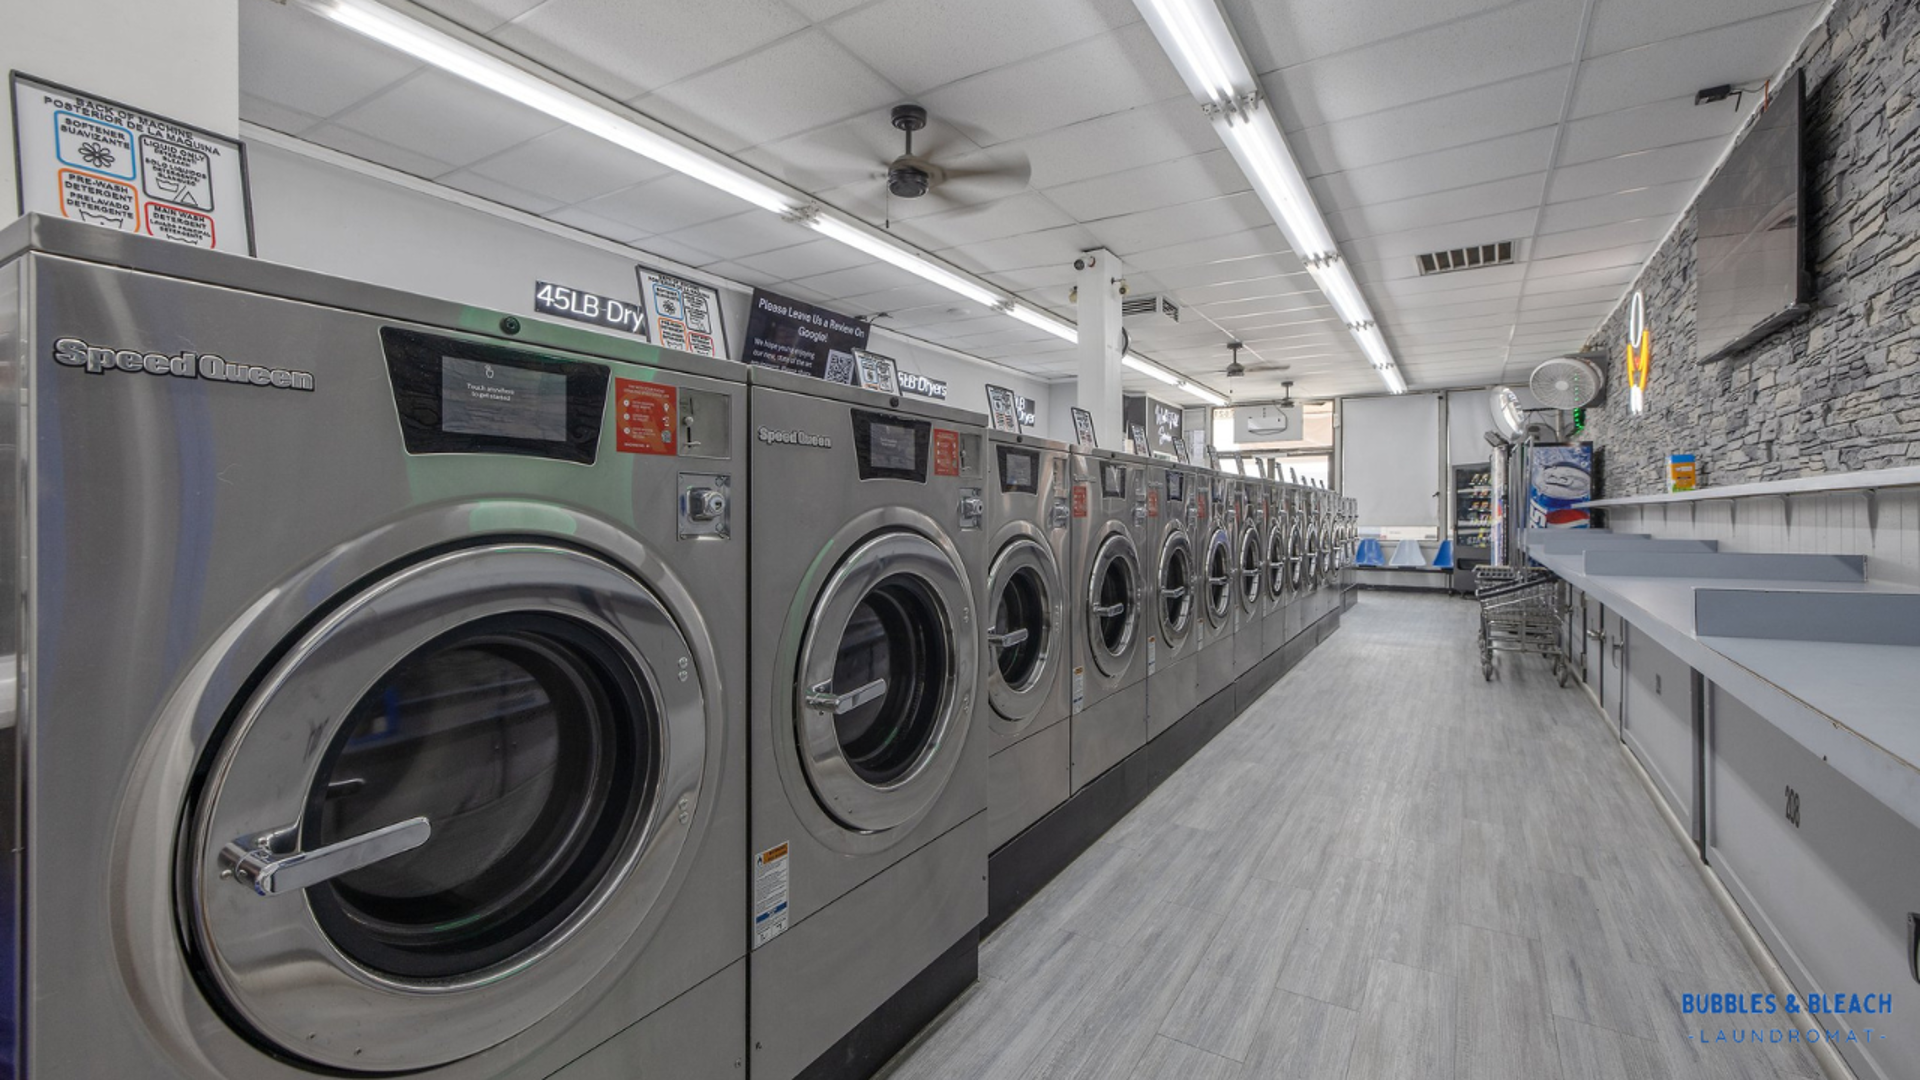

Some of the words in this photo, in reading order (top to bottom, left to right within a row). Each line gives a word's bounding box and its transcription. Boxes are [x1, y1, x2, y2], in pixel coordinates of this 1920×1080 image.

[44, 95, 123, 126] POSTERIOR
[127, 121, 144, 133] DE
[148, 127, 164, 139] LA
[166, 133, 221, 156] MAQUINA
[65, 117, 125, 140] SOFTENER
[76, 97, 114, 116] BACK
[118, 110, 135, 121] OF
[138, 116, 193, 140] MACHINE
[60, 125, 131, 150] SUAVIZANTE
[143, 138, 178, 154] LIQUID
[179, 149, 205, 163] ONLY
[145, 157, 169, 169] SOLO
[169, 165, 207, 180] LIQUIDOS
[64, 180, 133, 203] DETERGENT
[68, 173, 129, 194] PRE-WASH
[66, 198, 133, 219] DETERGENTE
[70, 191, 130, 211] PRELAVADO
[152, 212, 206, 230] DETERGENT
[154, 205, 177, 218] MAIN
[179, 211, 205, 223] WASH
[536, 283, 600, 318] 45LB
[759, 298, 787, 315] Please
[788, 307, 811, 322] Leave
[812, 314, 823, 327] Us
[823, 319, 829, 328] a
[829, 319, 853, 334] Review
[854, 327, 864, 338] On
[754, 337, 764, 346] We
[764, 339, 778, 350] hope
[797, 326, 829, 343] Google!
[53, 337, 198, 379] Speed
[198, 353, 315, 391] Queen
[466, 382, 486, 391] Touch
[758, 425, 797, 446] Speed
[797, 430, 832, 449] Queen
[1784, 784, 1801, 829] 208
